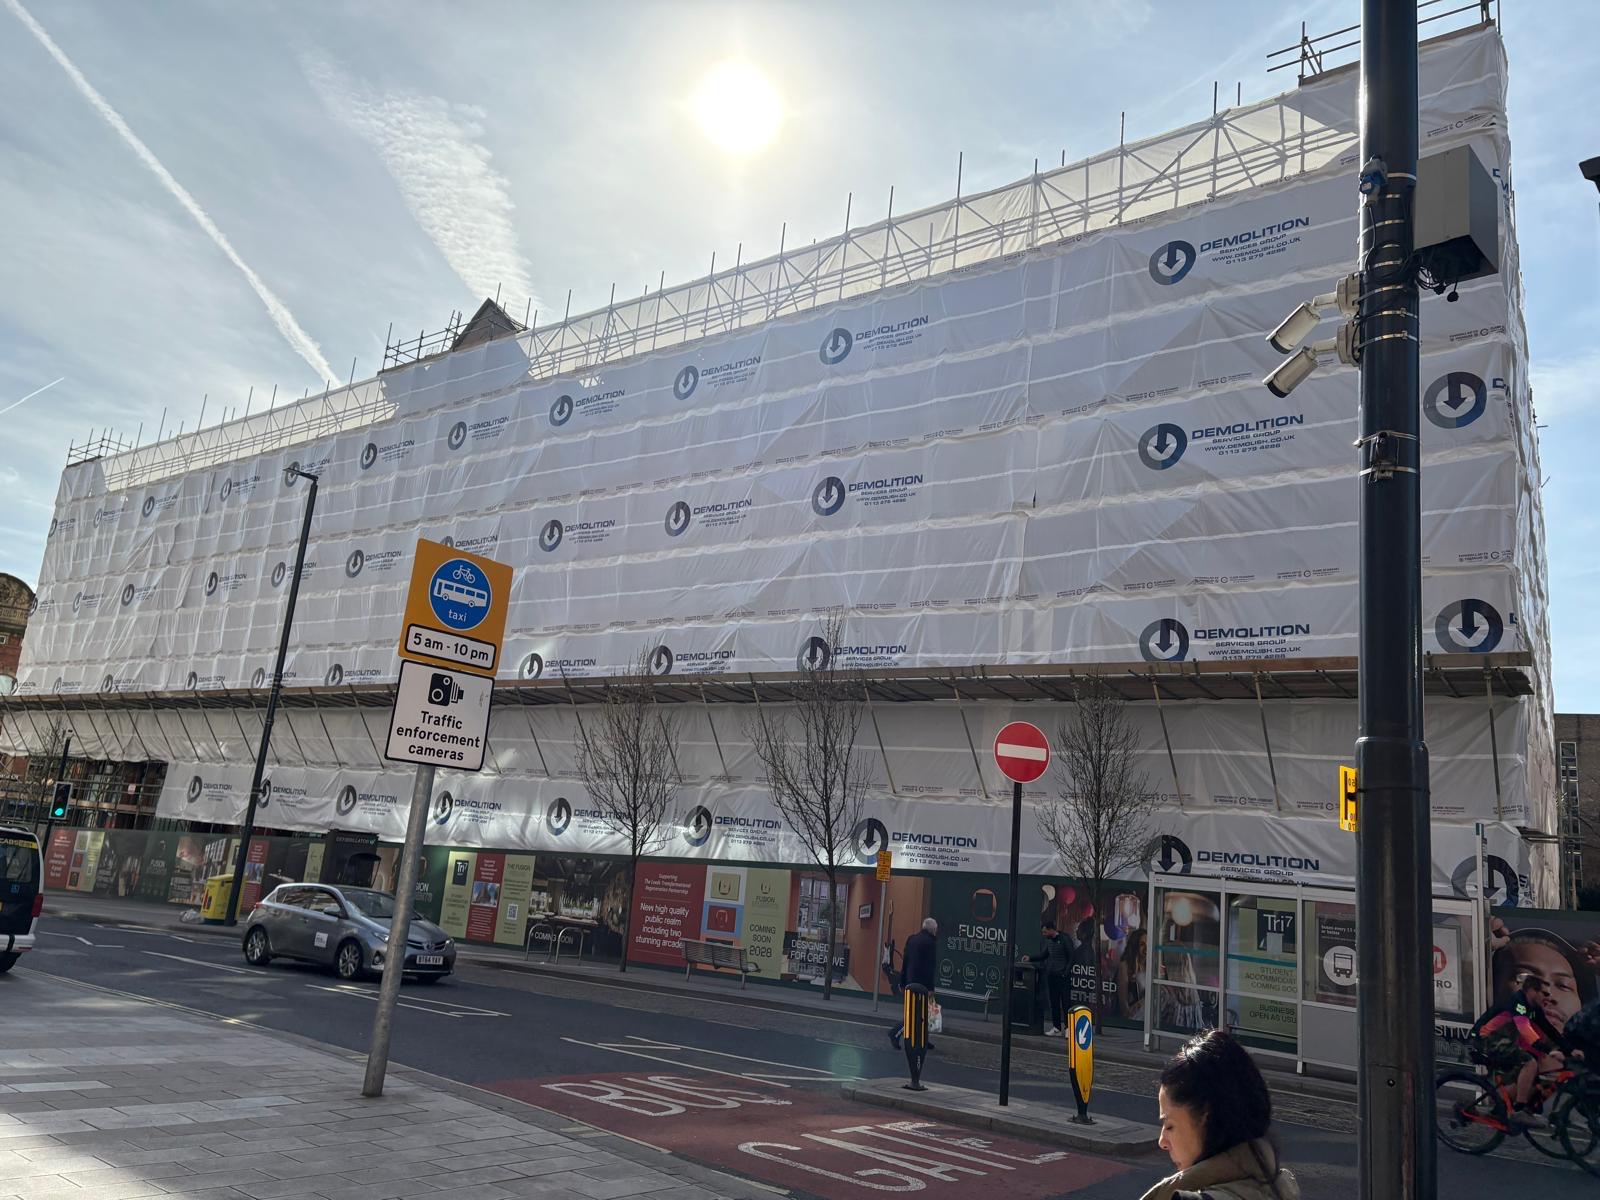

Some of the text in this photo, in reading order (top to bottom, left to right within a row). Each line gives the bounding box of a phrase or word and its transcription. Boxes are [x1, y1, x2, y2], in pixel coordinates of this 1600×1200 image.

[1200, 217, 1310, 252] DEMOLITION
[1220, 234, 1286, 254] SERVICES GROUP
[856, 315, 928, 341] DEMOLITION
[701, 356, 760, 376] DEMOLITION
[576, 389, 625, 407] DEMOLITION
[1192, 414, 1304, 439] DEMOLITION
[1212, 430, 1280, 443] SERVICES GROUP
[849, 474, 923, 491] DEMOLITION
[694, 499, 752, 514] DEMOLITION
[565, 520, 615, 532] DEMOLITION
[456, 535, 498, 547] DEMOLITION
[448, 608, 467, 622] taxi
[1194, 624, 1310, 639] DEMOLITION
[413, 633, 422, 646] 5
[424, 638, 443, 651] am
[454, 642, 468, 656] 10
[470, 648, 489, 661] pm
[834, 645, 906, 655] DEMOLITION
[1209, 647, 1301, 656] WWW.DEMOLISH.CO.UK
[676, 650, 736, 661] DEMOLITION
[545, 659, 596, 667] DEMOLITION
[421, 710, 462, 729] Traffic
[396, 727, 480, 748] enforcement
[408, 744, 464, 761] cameras
[273, 786, 307, 795] DEMOLITION
[359, 794, 398, 803] DEMOLITION
[455, 800, 501, 810] DEMOLITION
[715, 816, 781, 829] DEMOLITION
[892, 832, 977, 847] DEMOLITION
[1198, 851, 1319, 870] DEMOLITION
[640, 903, 689, 917] New high quality
[645, 915, 663, 923] public
[1264, 914, 1293, 932] Tri7
[642, 924, 681, 937] including two
[750, 924, 776, 934] COMING
[959, 924, 1007, 941] FUSION
[559, 935, 574, 944] OON
[636, 935, 660, 947] stunning
[753, 935, 771, 943] SOON
[749, 945, 772, 958] 2028
[792, 940, 829, 952] DESIGNED
[790, 951, 844, 967] FOR CREAIVE
[1261, 966, 1294, 976] STUDENT
[1071, 977, 1116, 992] UCCED
[1246, 973, 1296, 984] ACCOMMODAT
[1251, 981, 1278, 991] COMING
[1260, 1004, 1295, 1015] BUSINESS
[1250, 1010, 1269, 1019] OPEN
[1282, 1015, 1296, 1023] USU
[1435, 1025, 1470, 1039] SITIV
[541, 1074, 792, 1117] BUS
[737, 1122, 1068, 1192] GATE
